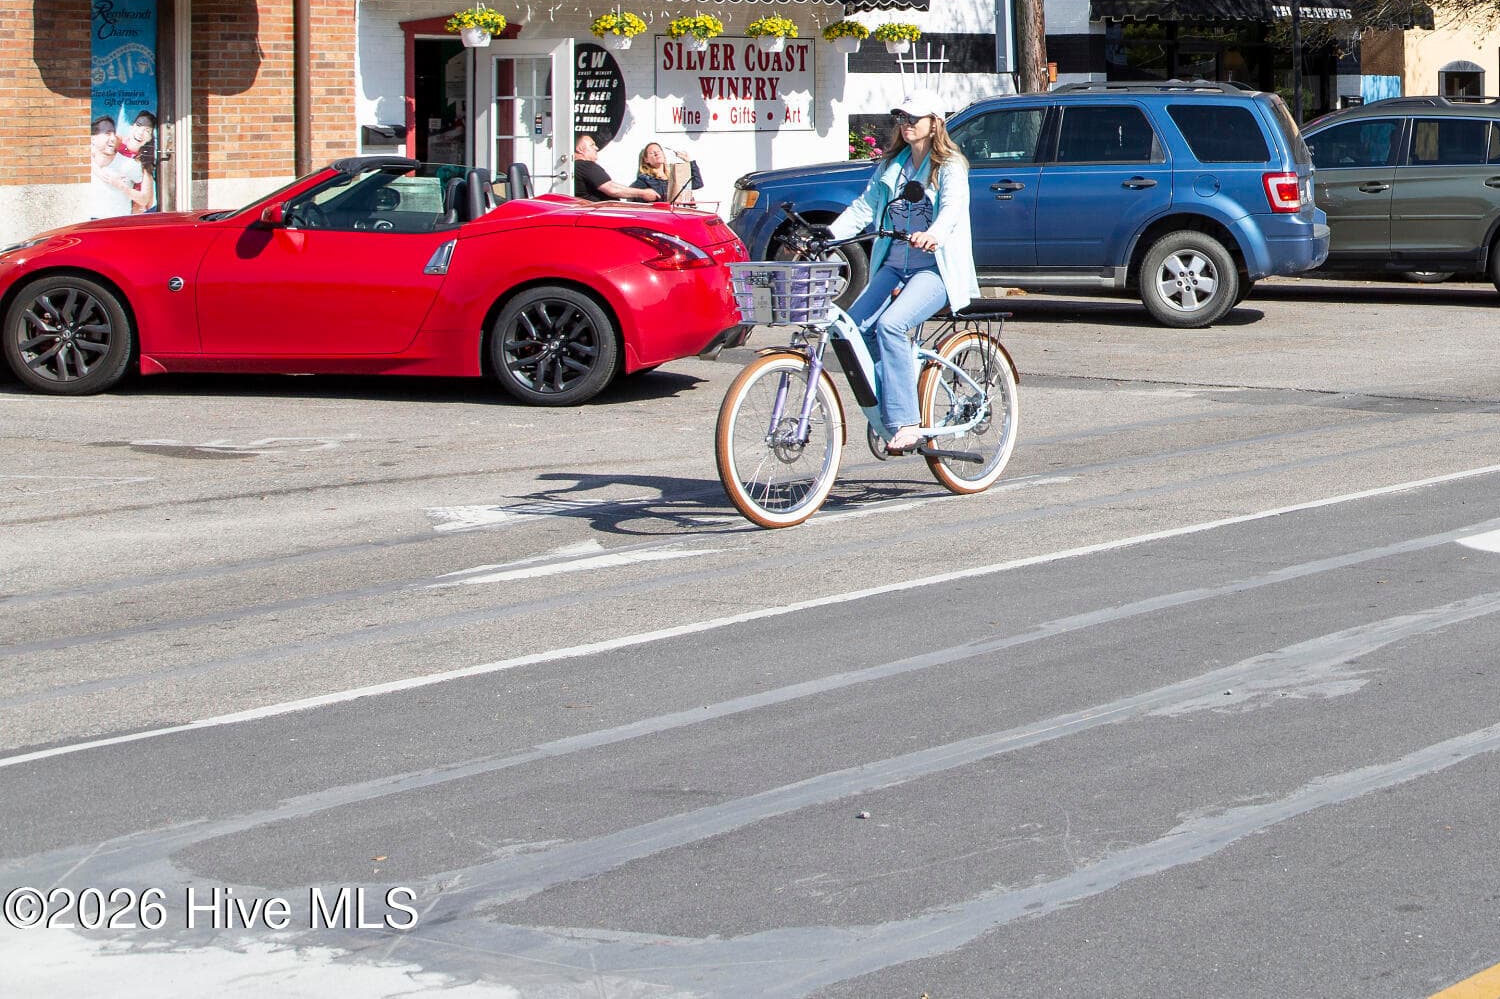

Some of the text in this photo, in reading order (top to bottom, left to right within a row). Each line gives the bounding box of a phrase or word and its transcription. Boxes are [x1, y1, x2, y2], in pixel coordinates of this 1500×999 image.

[91, 0, 152, 24] Rembrandt
[97, 23, 139, 40] Charms
[577, 51, 607, 69] CW
[663, 41, 809, 72] SILVER COAST
[586, 79, 610, 88] WINE
[698, 76, 780, 101] WINERY
[589, 91, 612, 101] BEER
[574, 104, 607, 114] STINGS
[672, 105, 801, 125] Wine Gifts Art
